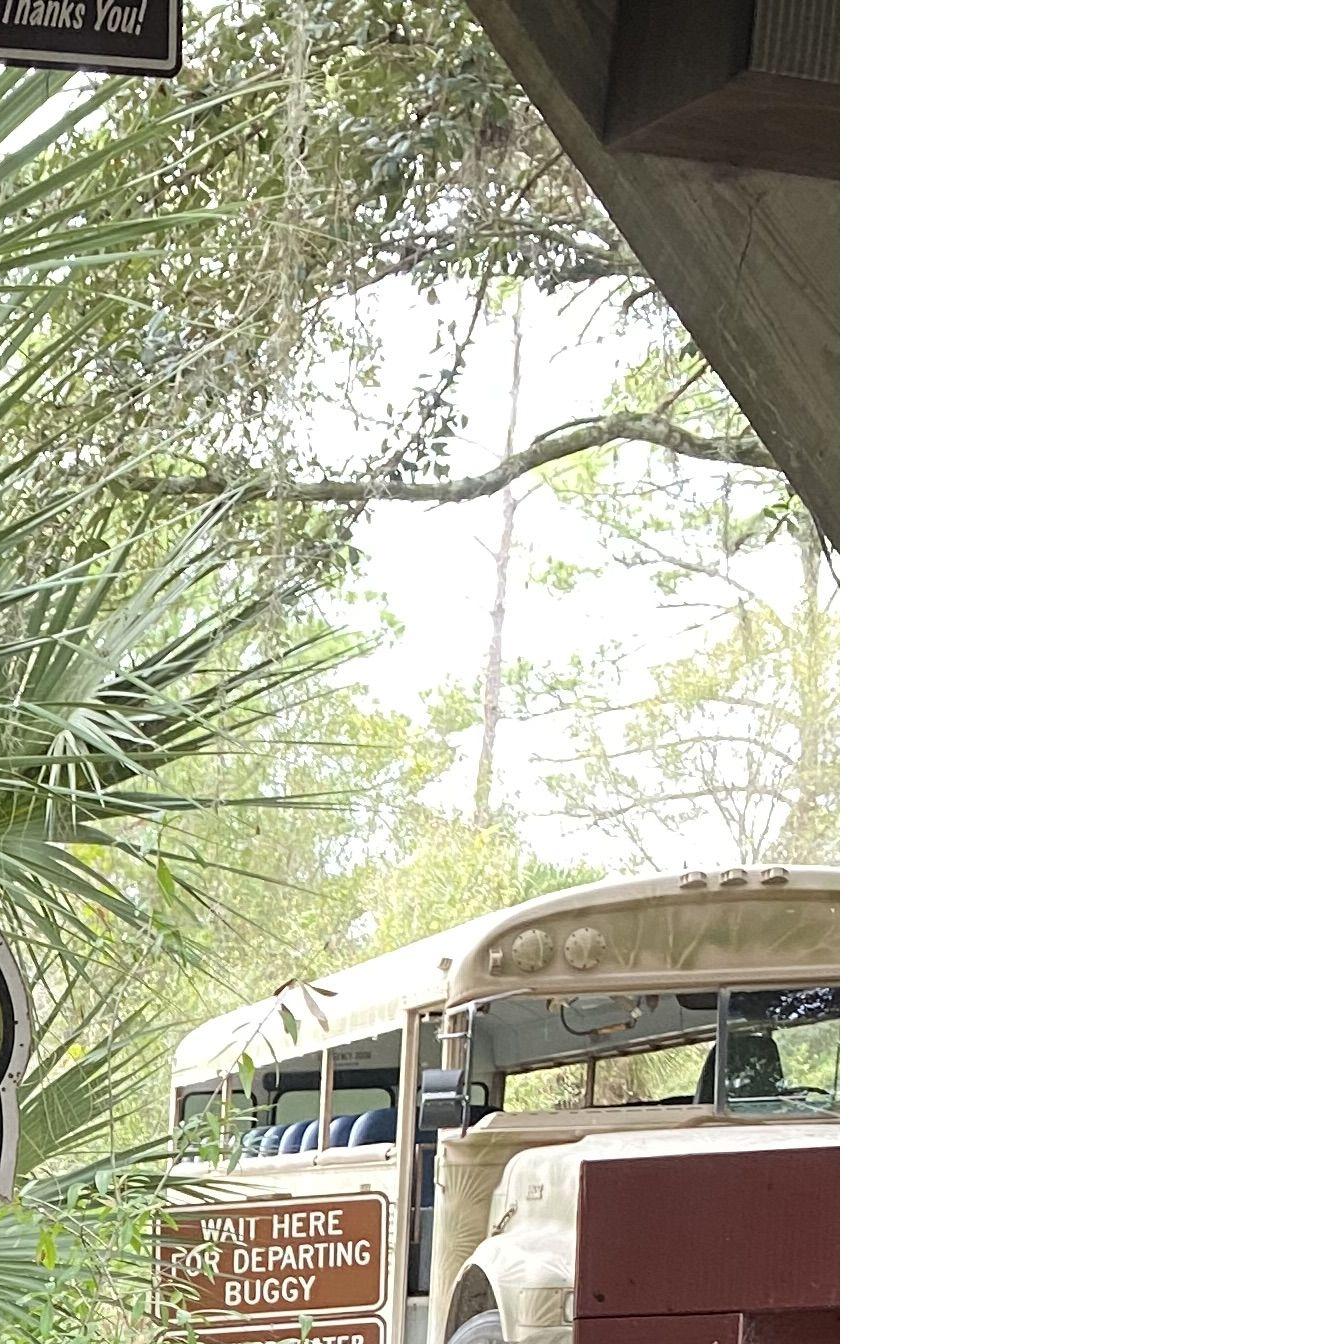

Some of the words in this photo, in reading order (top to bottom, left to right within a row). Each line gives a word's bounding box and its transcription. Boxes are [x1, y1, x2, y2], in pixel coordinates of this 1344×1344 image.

[1, 0, 84, 30] Thanks
[93, 0, 147, 36] You!
[200, 1217, 259, 1243] WAIT
[272, 1209, 344, 1240] HERE
[171, 1251, 220, 1278] FOR
[233, 1240, 371, 1274] DEPARTING
[224, 1275, 316, 1307] BUGGY
